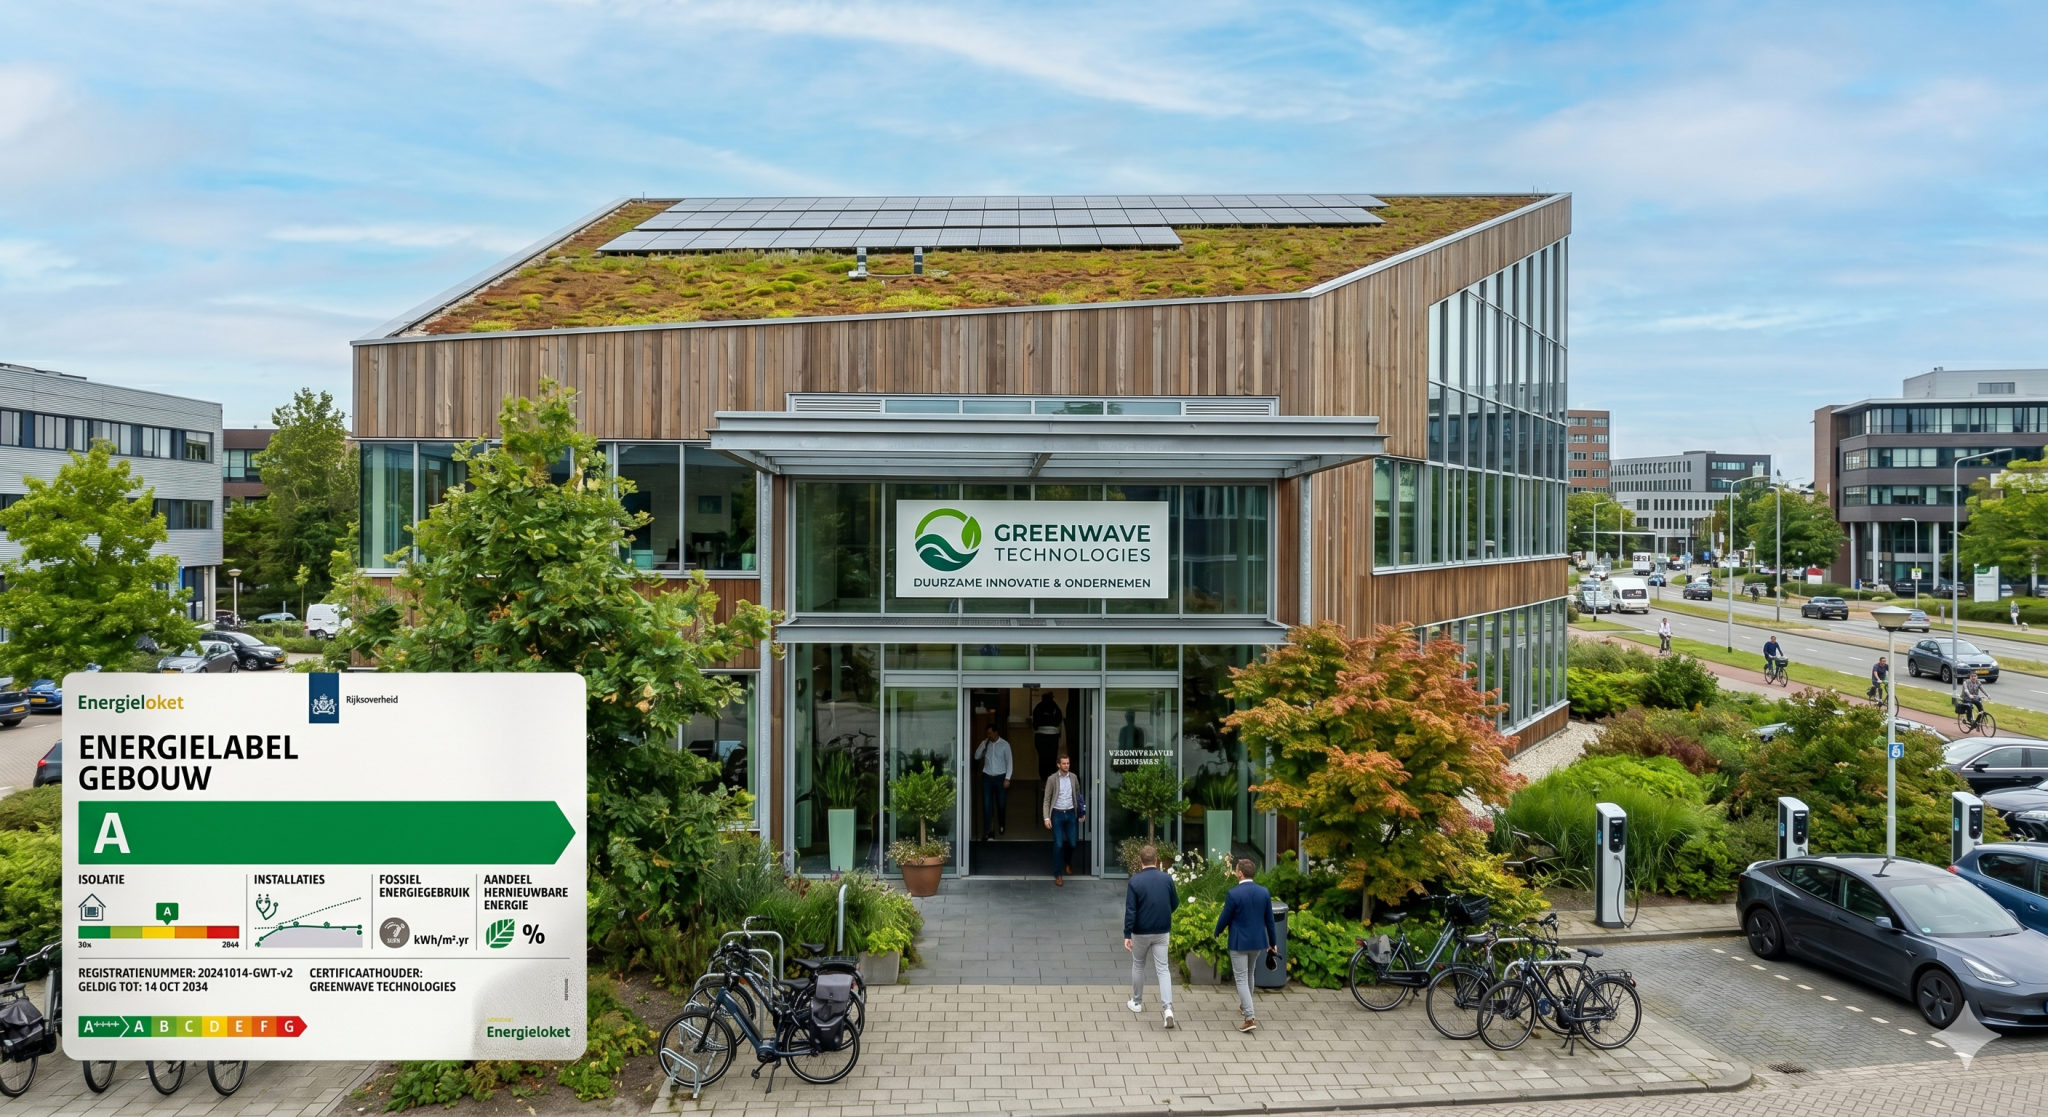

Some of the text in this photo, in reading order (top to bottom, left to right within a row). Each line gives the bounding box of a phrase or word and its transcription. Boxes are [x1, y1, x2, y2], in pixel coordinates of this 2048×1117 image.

[994, 523, 1151, 543] GREENWAVE
[993, 547, 1151, 563] TECHNOLOGIES
[913, 577, 1151, 588] DUURZAME INNOVATIE & ONDERNEMEN
